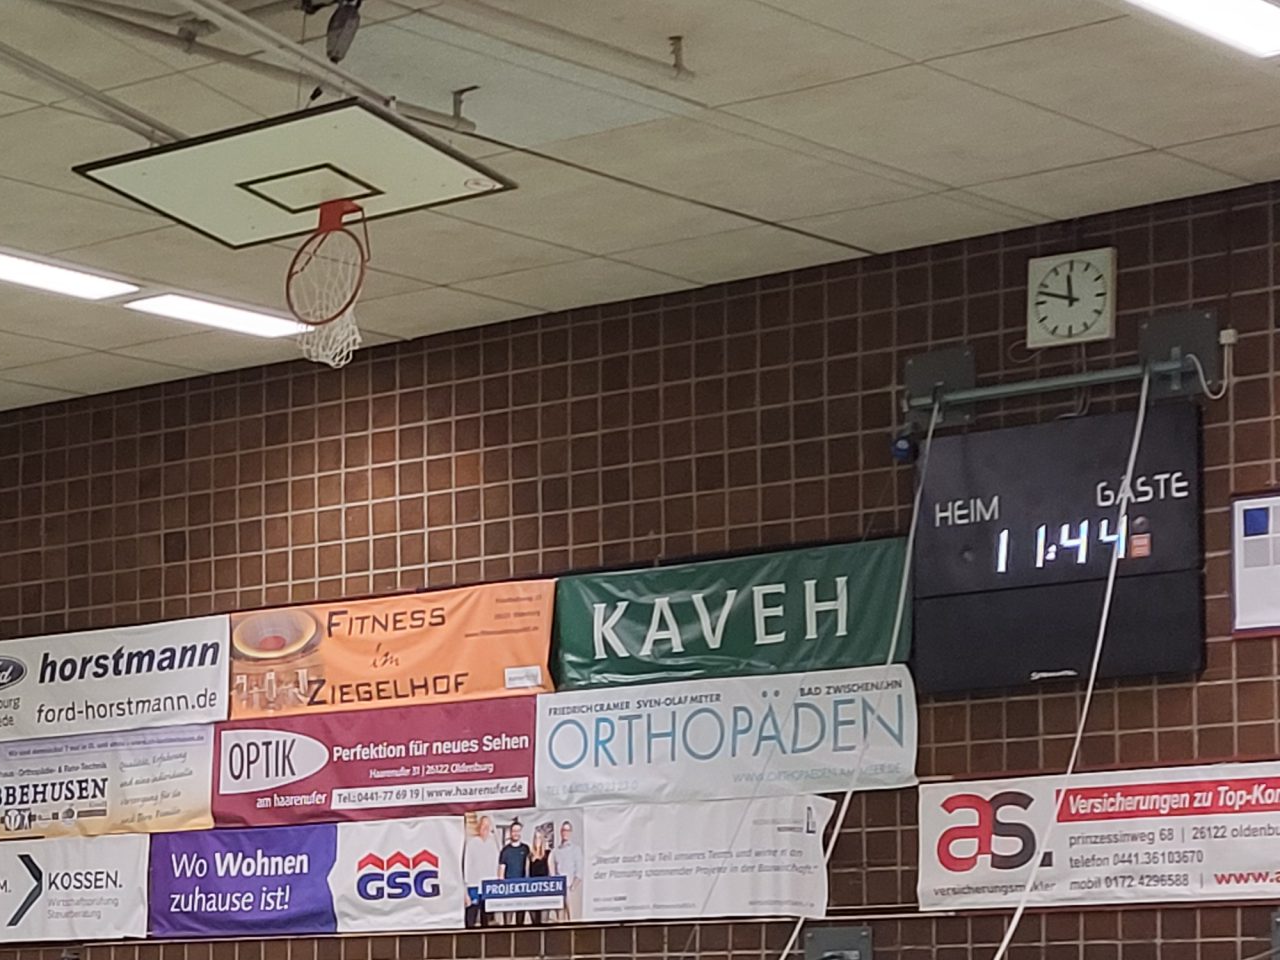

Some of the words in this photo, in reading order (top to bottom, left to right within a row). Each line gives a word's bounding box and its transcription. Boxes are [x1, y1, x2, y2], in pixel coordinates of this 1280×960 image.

[935, 495, 1000, 527] HEIM
[327, 607, 447, 638] FITNESS
[593, 576, 849, 660] KAVEH
[38, 641, 221, 684] horstmann
[307, 672, 470, 706] ZIEGELHOF
[36, 688, 218, 724] ford-horstmann.de
[548, 690, 904, 769] ORTHOPÄDEN
[229, 738, 297, 781] OPTIK
[332, 743, 406, 762] Perfektion
[408, 740, 428, 758] für
[430, 740, 478, 756] neues
[482, 733, 529, 751] Sehen
[256, 797, 271, 809] am
[273, 791, 328, 808] haarenufer
[410, 788, 419, 798] 19
[427, 782, 523, 798] www.haarenufer.de
[1070, 792, 1189, 814] Versicherungen
[1193, 791, 1213, 808] zu
[171, 853, 207, 878] Wo
[215, 849, 309, 877] Wohnen
[1070, 855, 1109, 868] telefon
[47, 870, 123, 890] KOSSEN.
[356, 869, 441, 901] GSG
[486, 881, 563, 895] PROJEKTLOTSEN
[933, 880, 1057, 897] versicherungsmkler
[170, 887, 253, 912] zuhause
[259, 885, 291, 911] ist!
